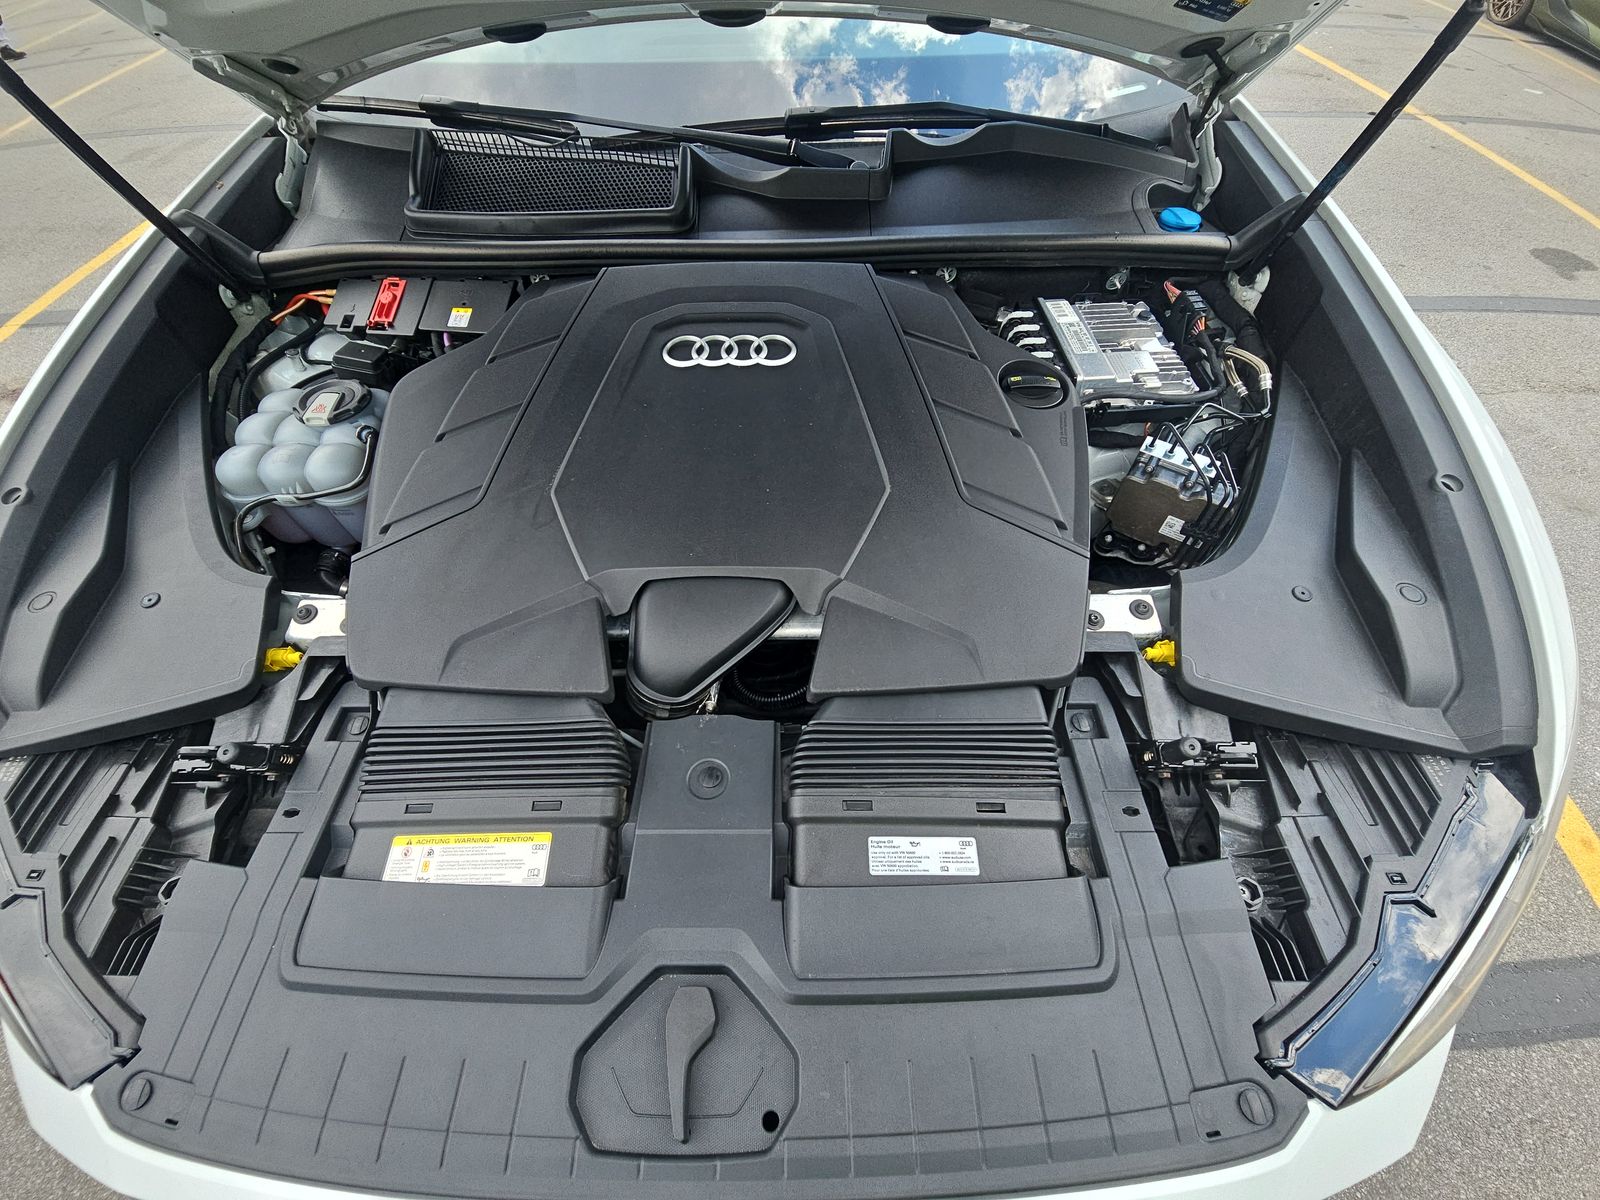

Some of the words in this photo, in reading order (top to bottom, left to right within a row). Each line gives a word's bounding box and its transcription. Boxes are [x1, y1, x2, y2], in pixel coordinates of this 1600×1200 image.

[415, 837, 450, 845] ACHTUNG
[454, 836, 490, 844] WARNING
[493, 835, 535, 843] ATTENTION
